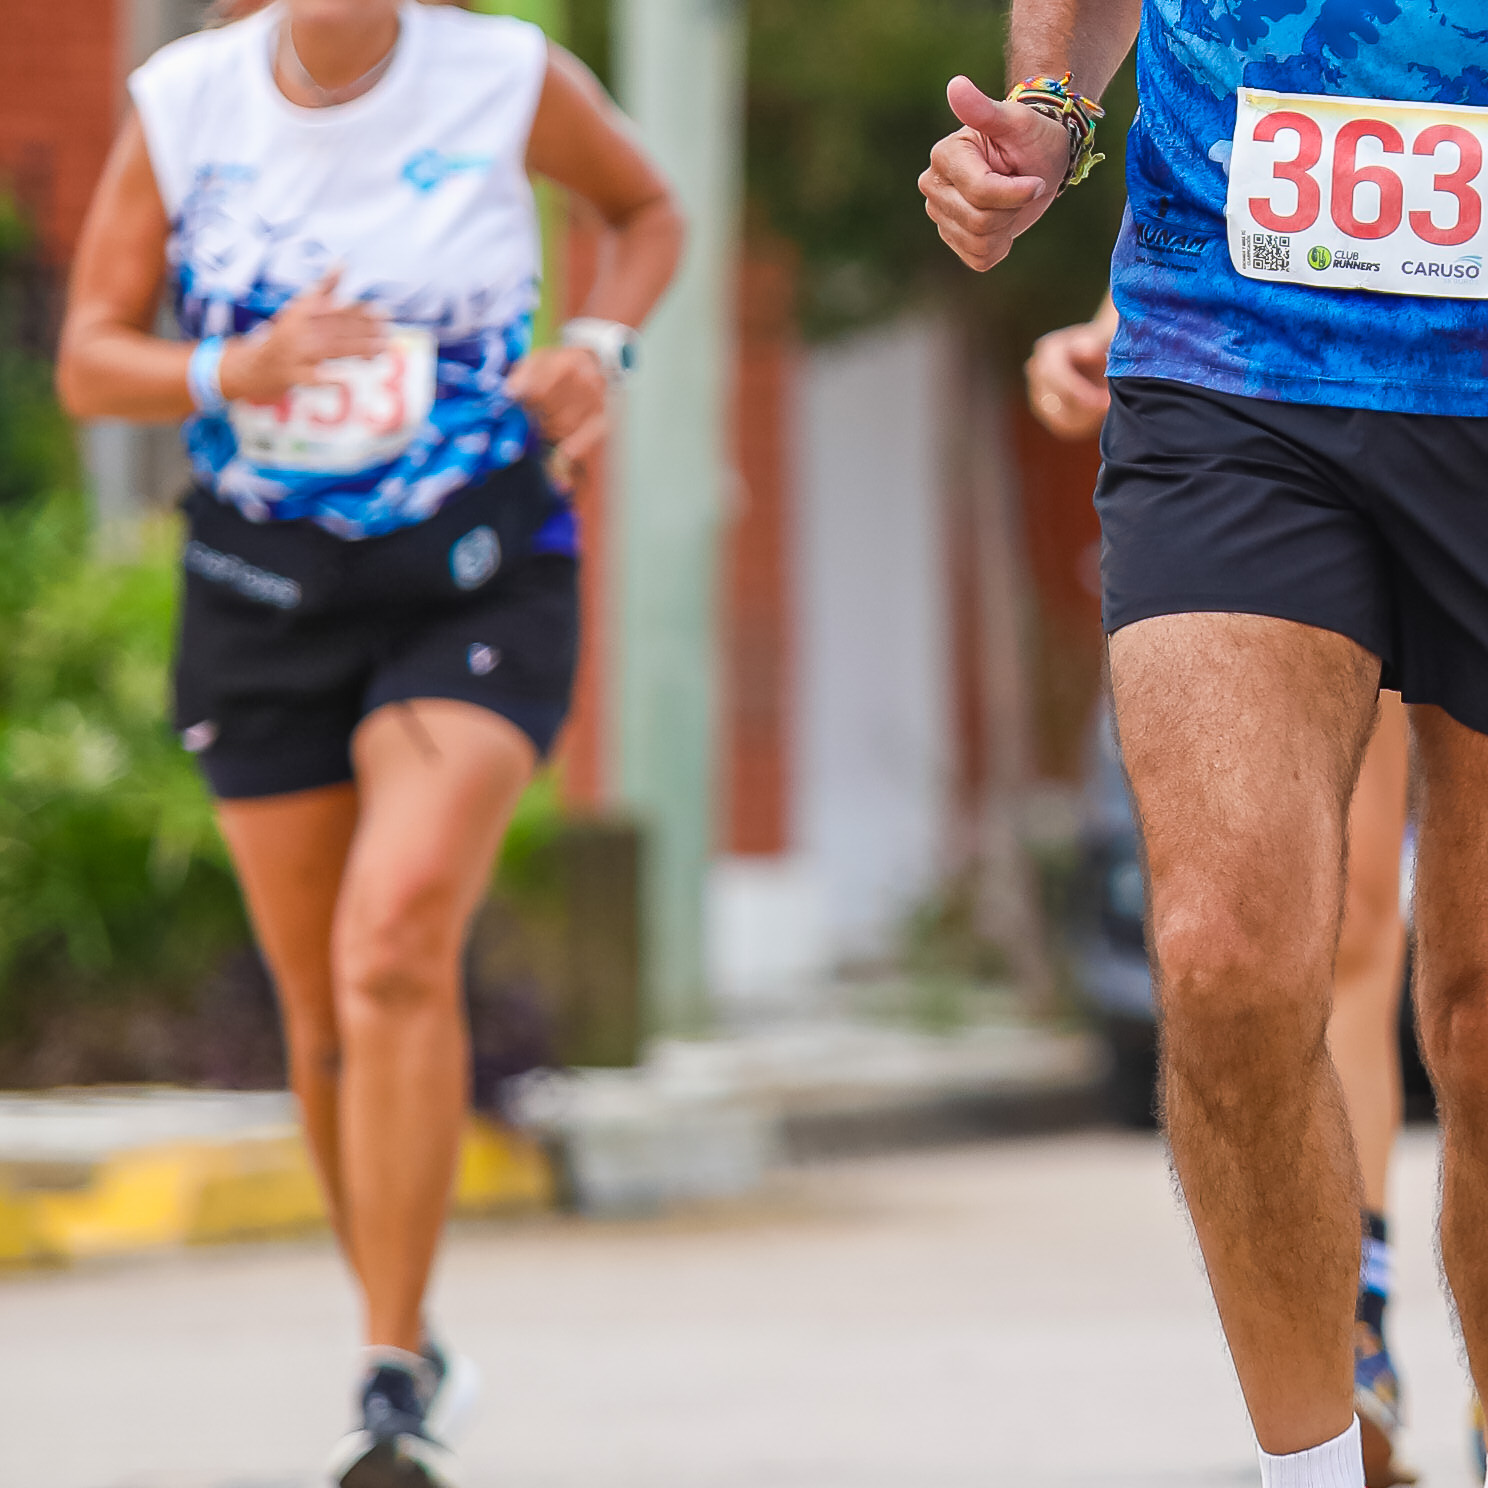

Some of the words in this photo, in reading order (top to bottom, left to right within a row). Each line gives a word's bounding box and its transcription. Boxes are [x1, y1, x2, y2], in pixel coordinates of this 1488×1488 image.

[1247, 110, 1483, 247] 363
[1334, 250, 1359, 260] CLUB
[1332, 259, 1381, 272] RUNNER'S
[1401, 260, 1480, 279] CARUSO
